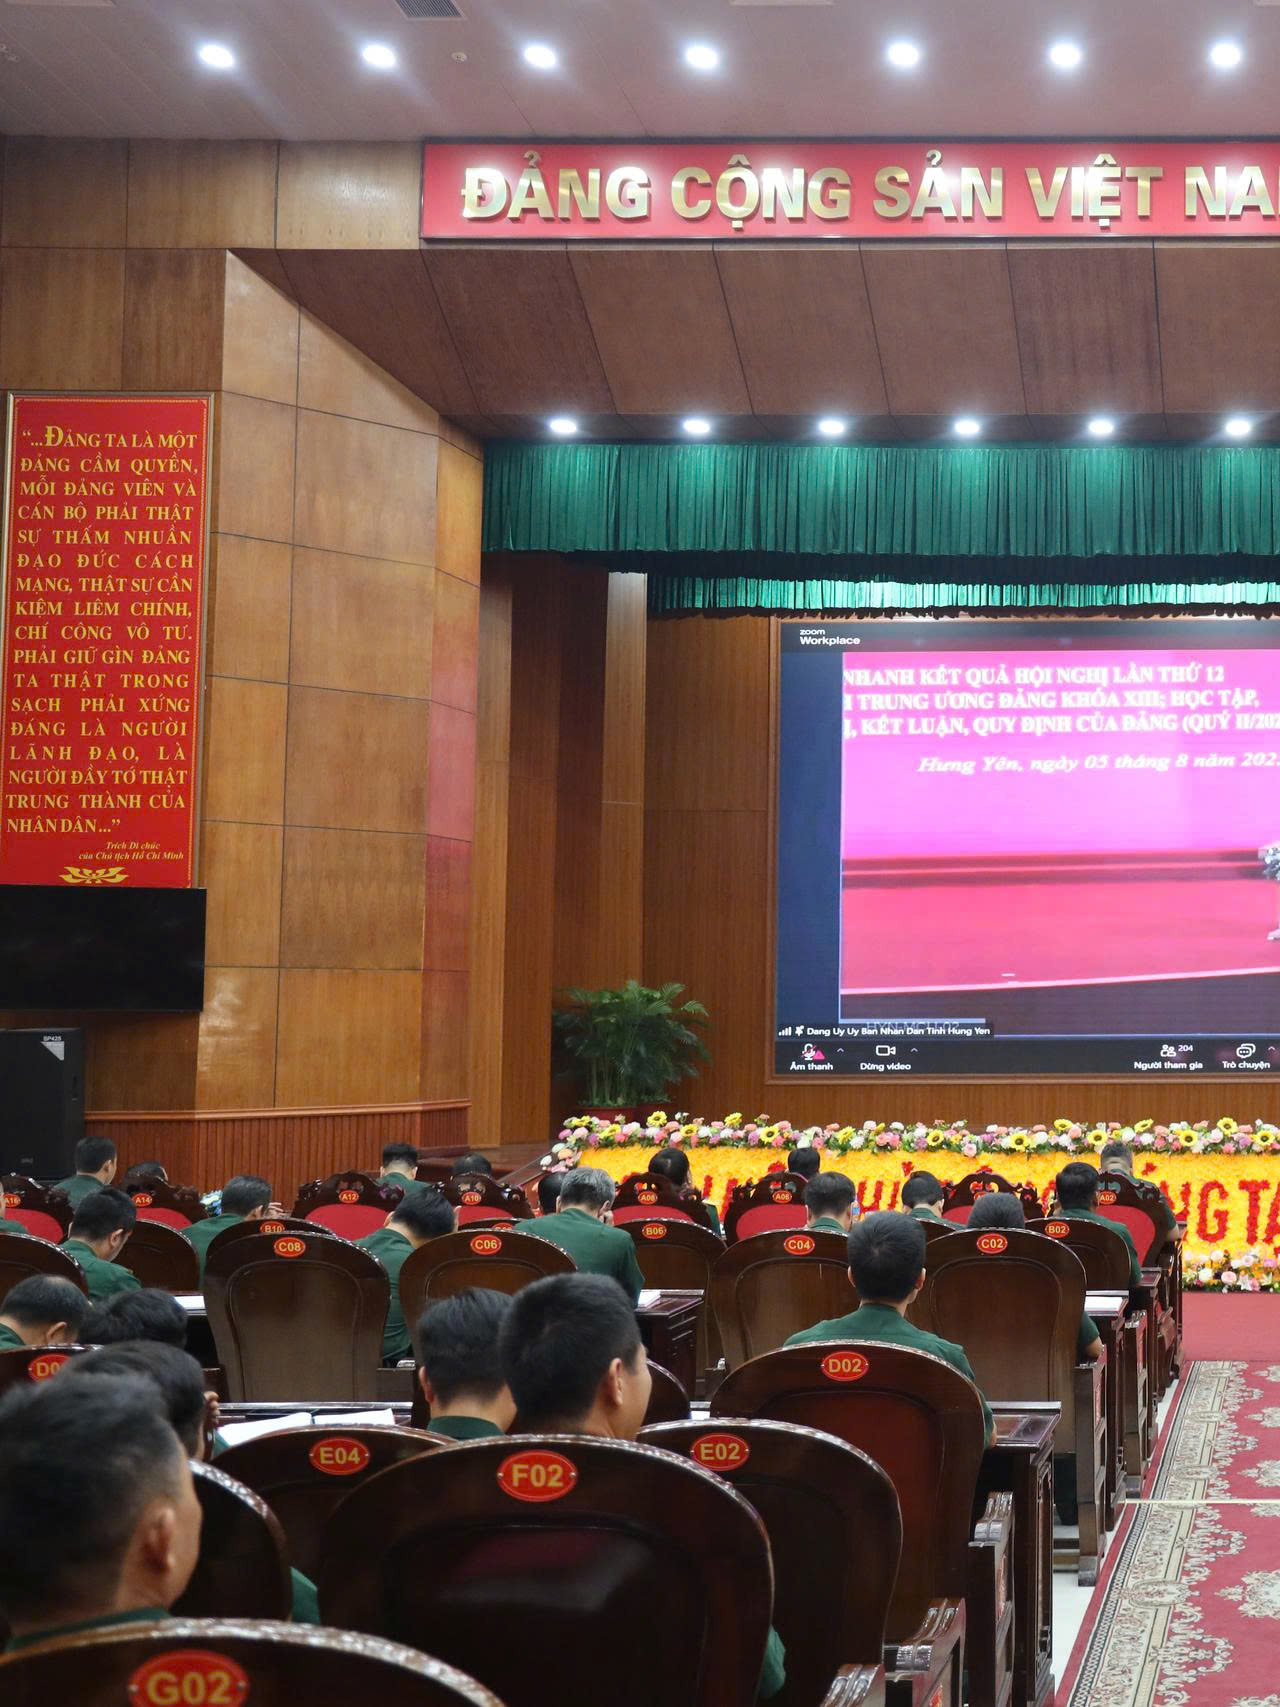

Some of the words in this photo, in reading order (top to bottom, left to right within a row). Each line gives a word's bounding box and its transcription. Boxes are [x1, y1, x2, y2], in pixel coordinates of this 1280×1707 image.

[462, 151, 652, 220] ĐẢNG
[671, 154, 850, 228] CỘNG
[873, 150, 1003, 218] SẢN
[1024, 154, 1164, 227] VIỆT
[105, 434, 127, 447] TA
[132, 431, 156, 448] LÀ
[158, 431, 197, 451] MỘT
[21, 454, 70, 472] ĐẢNG
[80, 452, 119, 472] CẦM
[131, 453, 198, 475] QUYỀN,
[20, 474, 55, 496] MỖI
[64, 478, 114, 496] ĐẢNG
[124, 479, 164, 496] VIÊN
[175, 479, 197, 496] VÀ
[18, 502, 54, 520] CÁN
[64, 502, 87, 522] BỘ
[96, 502, 137, 520] PHẢI
[146, 504, 193, 523] THẬT
[18, 529, 41, 546] SỰ
[53, 526, 110, 544] THẤM
[124, 524, 192, 544] NHUẦN
[800, 636, 860, 646] Workplace
[843, 669, 914, 685] NHANH
[920, 664, 962, 685] KẾT
[966, 665, 1008, 688] QUẢ
[1015, 666, 1052, 687] HỘI
[1057, 667, 1107, 687] NGHỊ
[1113, 662, 1153, 683] LẦN
[1158, 662, 1202, 682] THỨ
[1206, 666, 1224, 682] 12
[858, 694, 928, 710] TRUNG
[935, 691, 993, 709] ƯƠNG
[999, 688, 1056, 708] ĐẢNG
[1061, 688, 1119, 707] KHÓA
[1171, 690, 1213, 709] HỌC
[861, 714, 903, 735] KẾT
[908, 716, 969, 738] LUẬN,
[973, 717, 1015, 735] QUY
[1021, 715, 1072, 736] ĐỊNH
[1076, 711, 1118, 732] CỦA
[1122, 711, 1177, 732] ĐẢNG
[1084, 755, 1108, 769] 05
[1175, 753, 1188, 768] 8
[7, 816, 57, 833] NHÂN
[807, 1028, 830, 1036] Dang
[808, 1062, 833, 1071] thanh
[886, 1062, 911, 1071] video
[1164, 1061, 1187, 1069] tham
[1189, 1062, 1203, 1070] gia
[341, 1193, 357, 1201] A12
[464, 1194, 480, 1203] A10
[1100, 1193, 1115, 1202] A02
[645, 1227, 664, 1236] B06
[1048, 1225, 1067, 1234] B02
[279, 1241, 301, 1252] C08
[475, 1239, 498, 1250] C06
[788, 1239, 811, 1250] C04
[981, 1238, 1004, 1249] C02
[828, 1358, 863, 1374] D02
[319, 1447, 361, 1466] E04
[699, 1441, 741, 1461] E02
[511, 1462, 565, 1489] F02
[146, 1670, 232, 1704] G02
